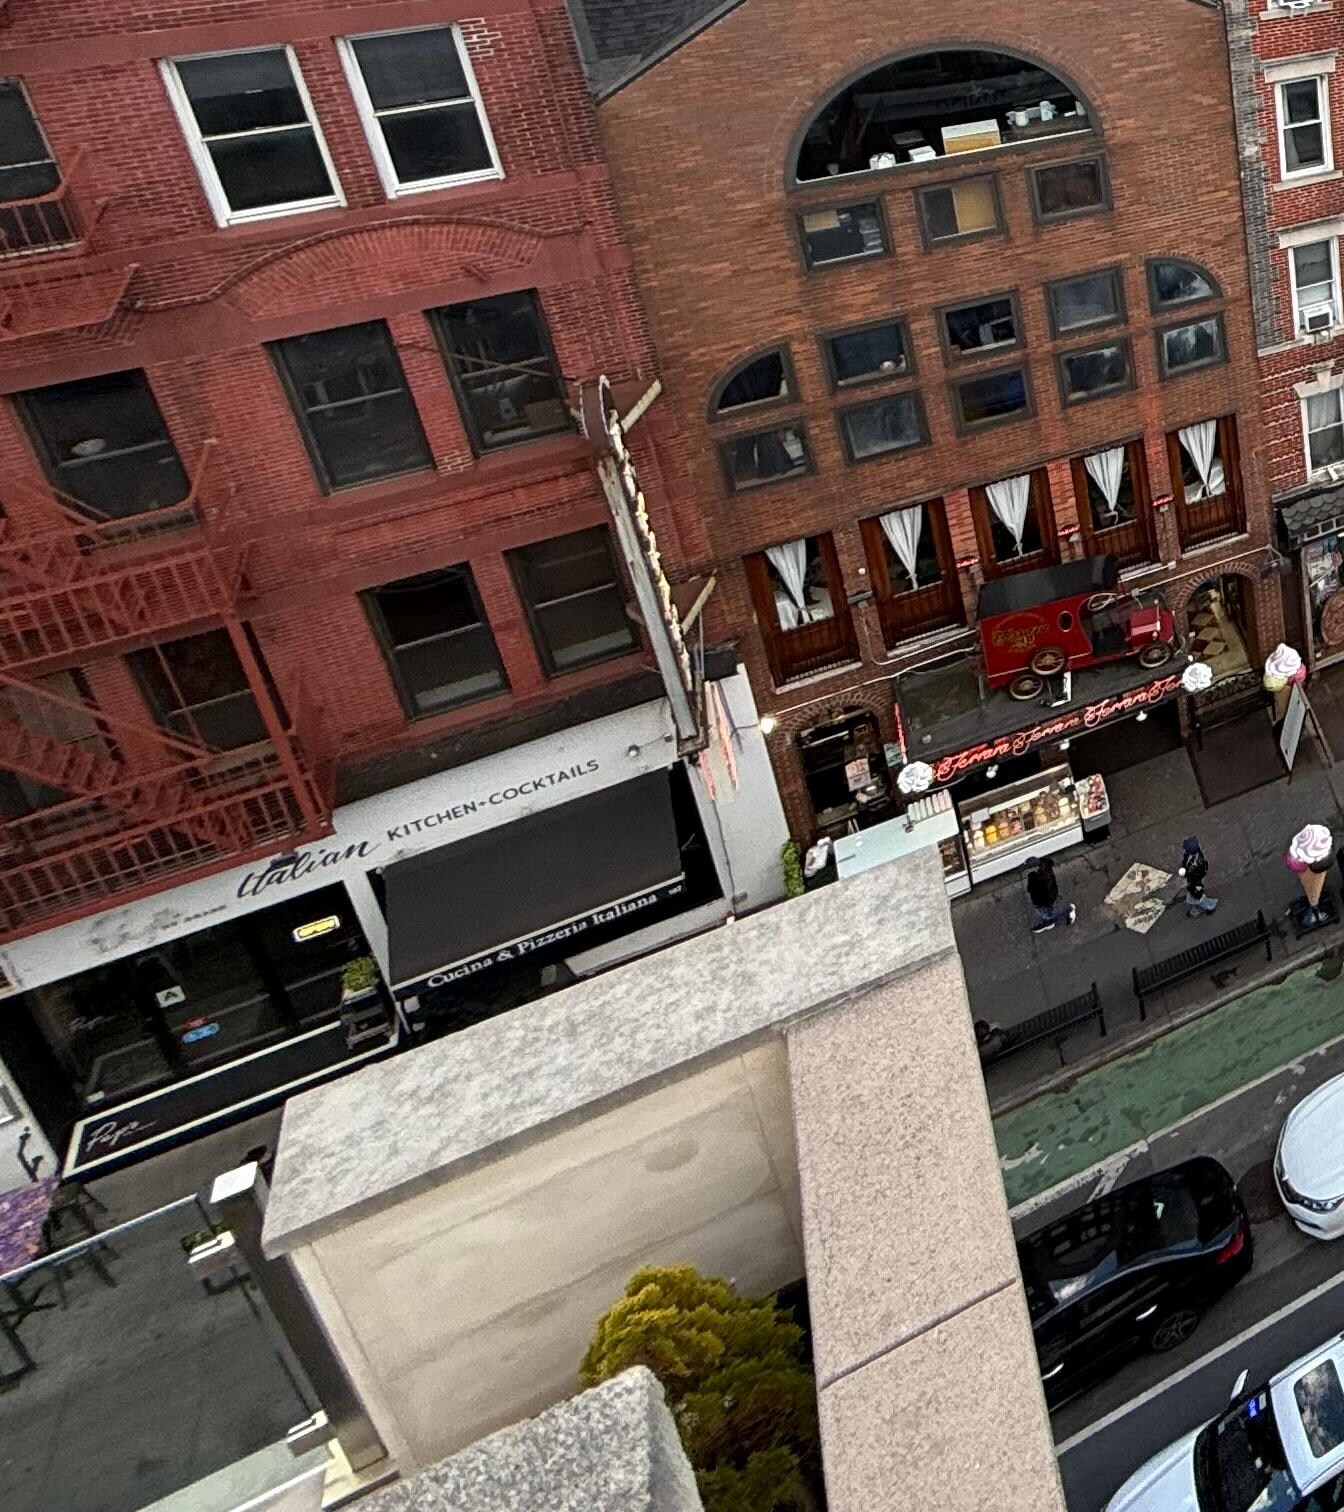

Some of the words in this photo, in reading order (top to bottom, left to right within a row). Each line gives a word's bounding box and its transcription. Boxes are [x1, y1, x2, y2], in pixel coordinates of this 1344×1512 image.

[937, 740, 1012, 782] Ferrara
[1084, 690, 1149, 728] Ferrara
[236, 839, 382, 899] Italian
[427, 956, 493, 989] Cucina
[498, 947, 513, 962] &
[516, 920, 587, 956] Pizzeria
[591, 891, 658, 927] Italiana
[163, 990, 180, 1003] A
